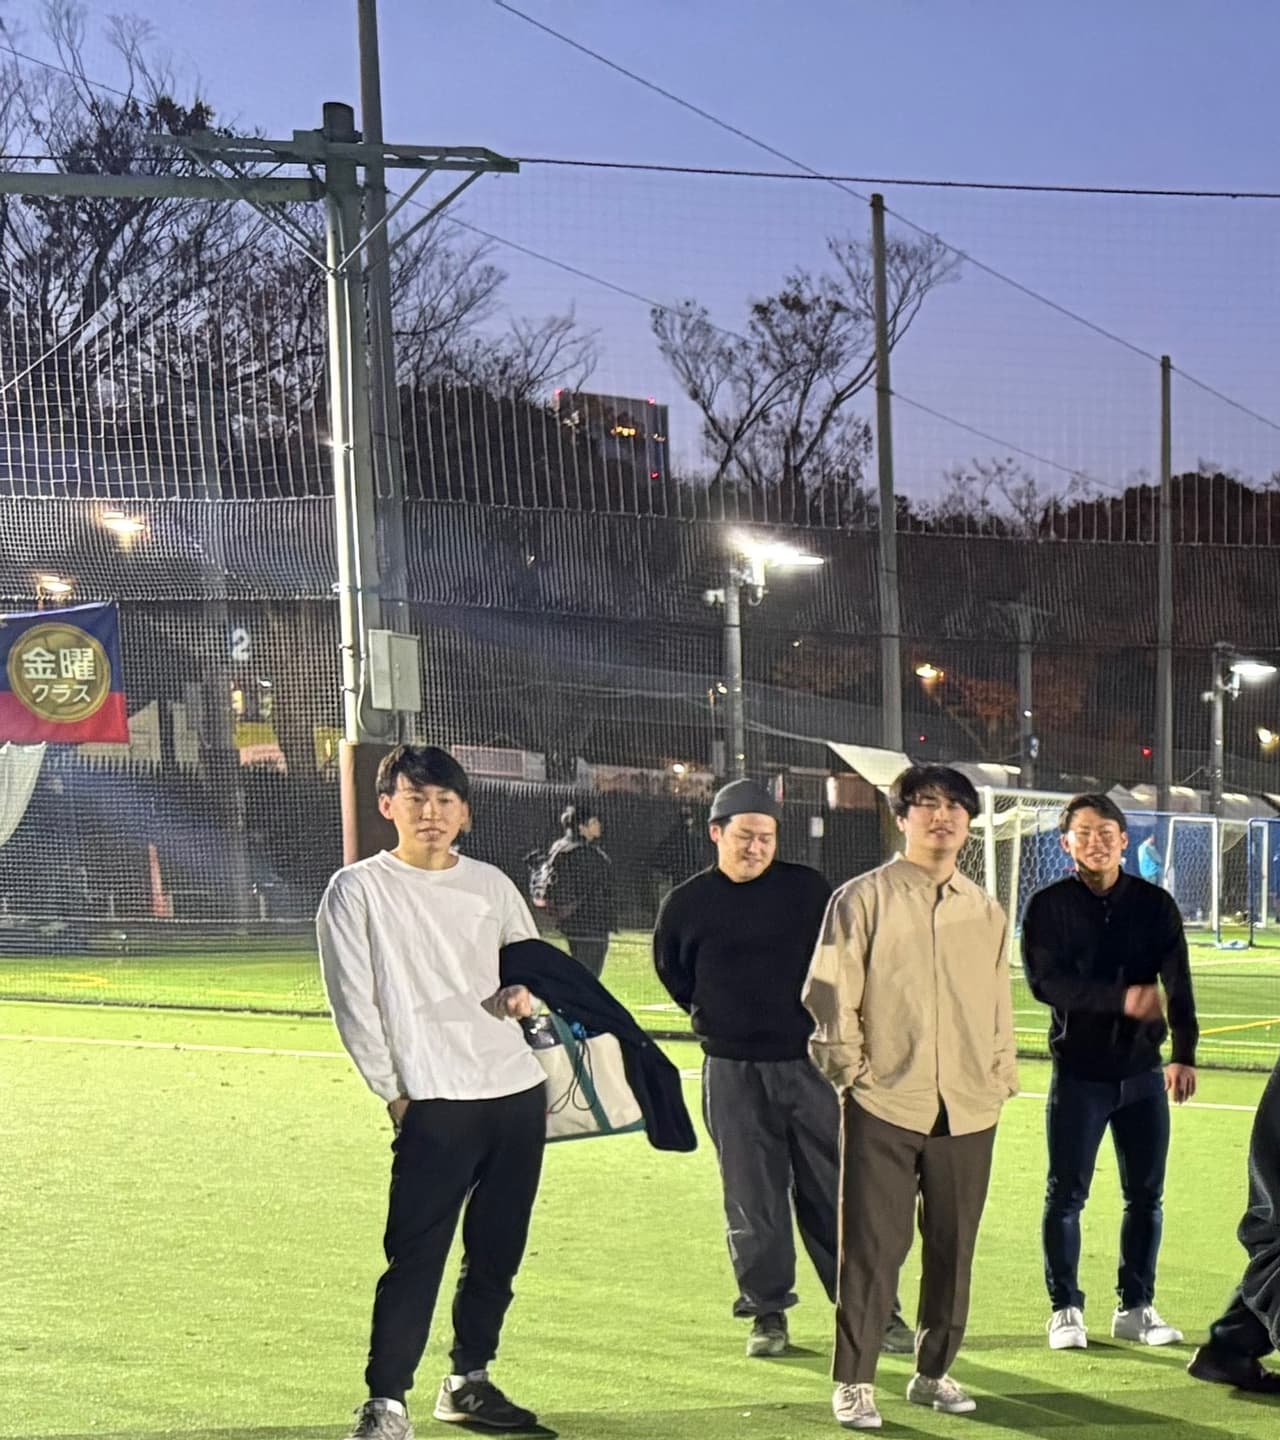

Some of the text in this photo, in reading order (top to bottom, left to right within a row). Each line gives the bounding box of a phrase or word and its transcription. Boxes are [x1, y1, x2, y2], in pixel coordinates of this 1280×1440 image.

[232, 628, 249, 661] 2
[22, 646, 97, 680] 金曜
[32, 684, 91, 703] クラス
